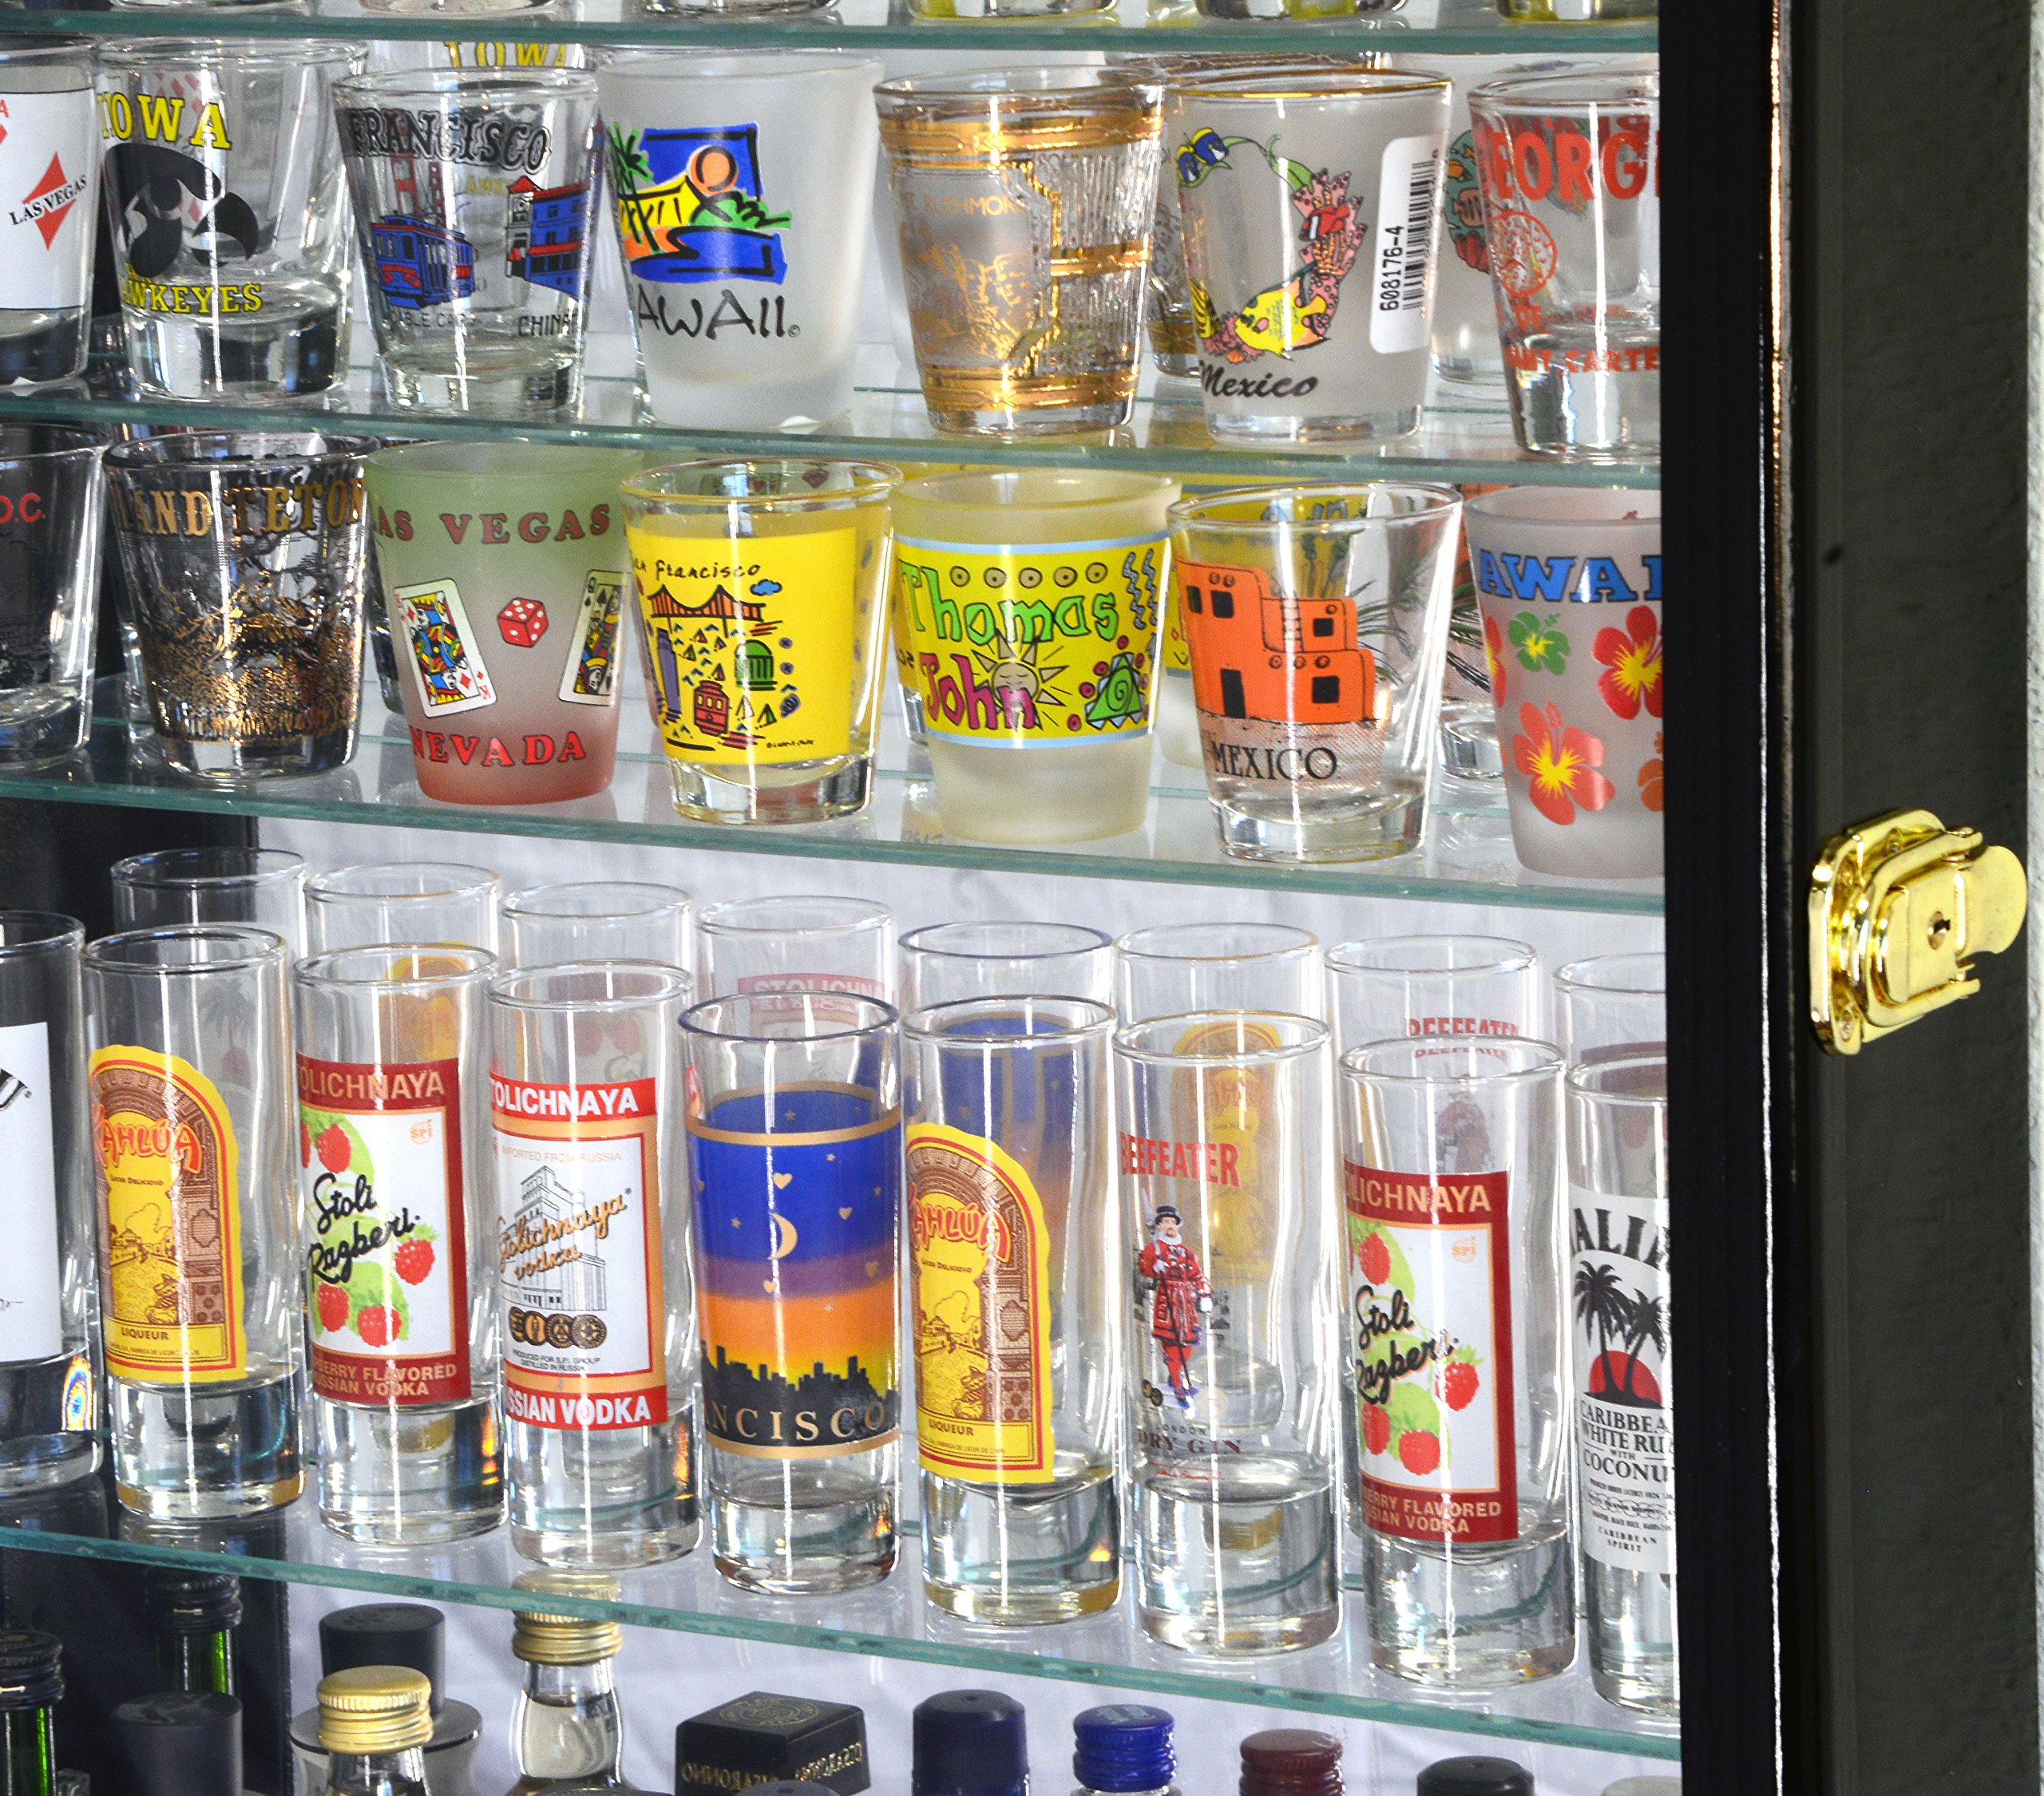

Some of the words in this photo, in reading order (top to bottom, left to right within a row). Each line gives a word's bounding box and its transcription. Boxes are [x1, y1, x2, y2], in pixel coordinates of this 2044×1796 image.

[1483, 129, 1661, 200] EORG
[9, 201, 43, 226] LAS
[43, 173, 88, 212] VEGAS
[1380, 225, 1404, 311] 608176-4
[1198, 359, 1319, 398] Mexico
[439, 503, 612, 545] VEGAS
[898, 558, 1119, 647] Thomas
[919, 652, 1037, 731] John
[410, 725, 587, 767] NEVADA
[1210, 740, 1338, 781] MEXICO
[1119, 1130, 1240, 1188] BEEFEATER
[121, 1326, 169, 1341] LIQUEUR
[362, 1363, 458, 1382] FLAVORED
[364, 1381, 430, 1396] VODKA
[560, 1394, 652, 1426] VODKA
[707, 1391, 885, 1442] NCISCO
[928, 1418, 974, 1437] LIQUEUR
[1403, 1498, 1502, 1517] FLAVORED
[1404, 1515, 1470, 1534] VODKA
